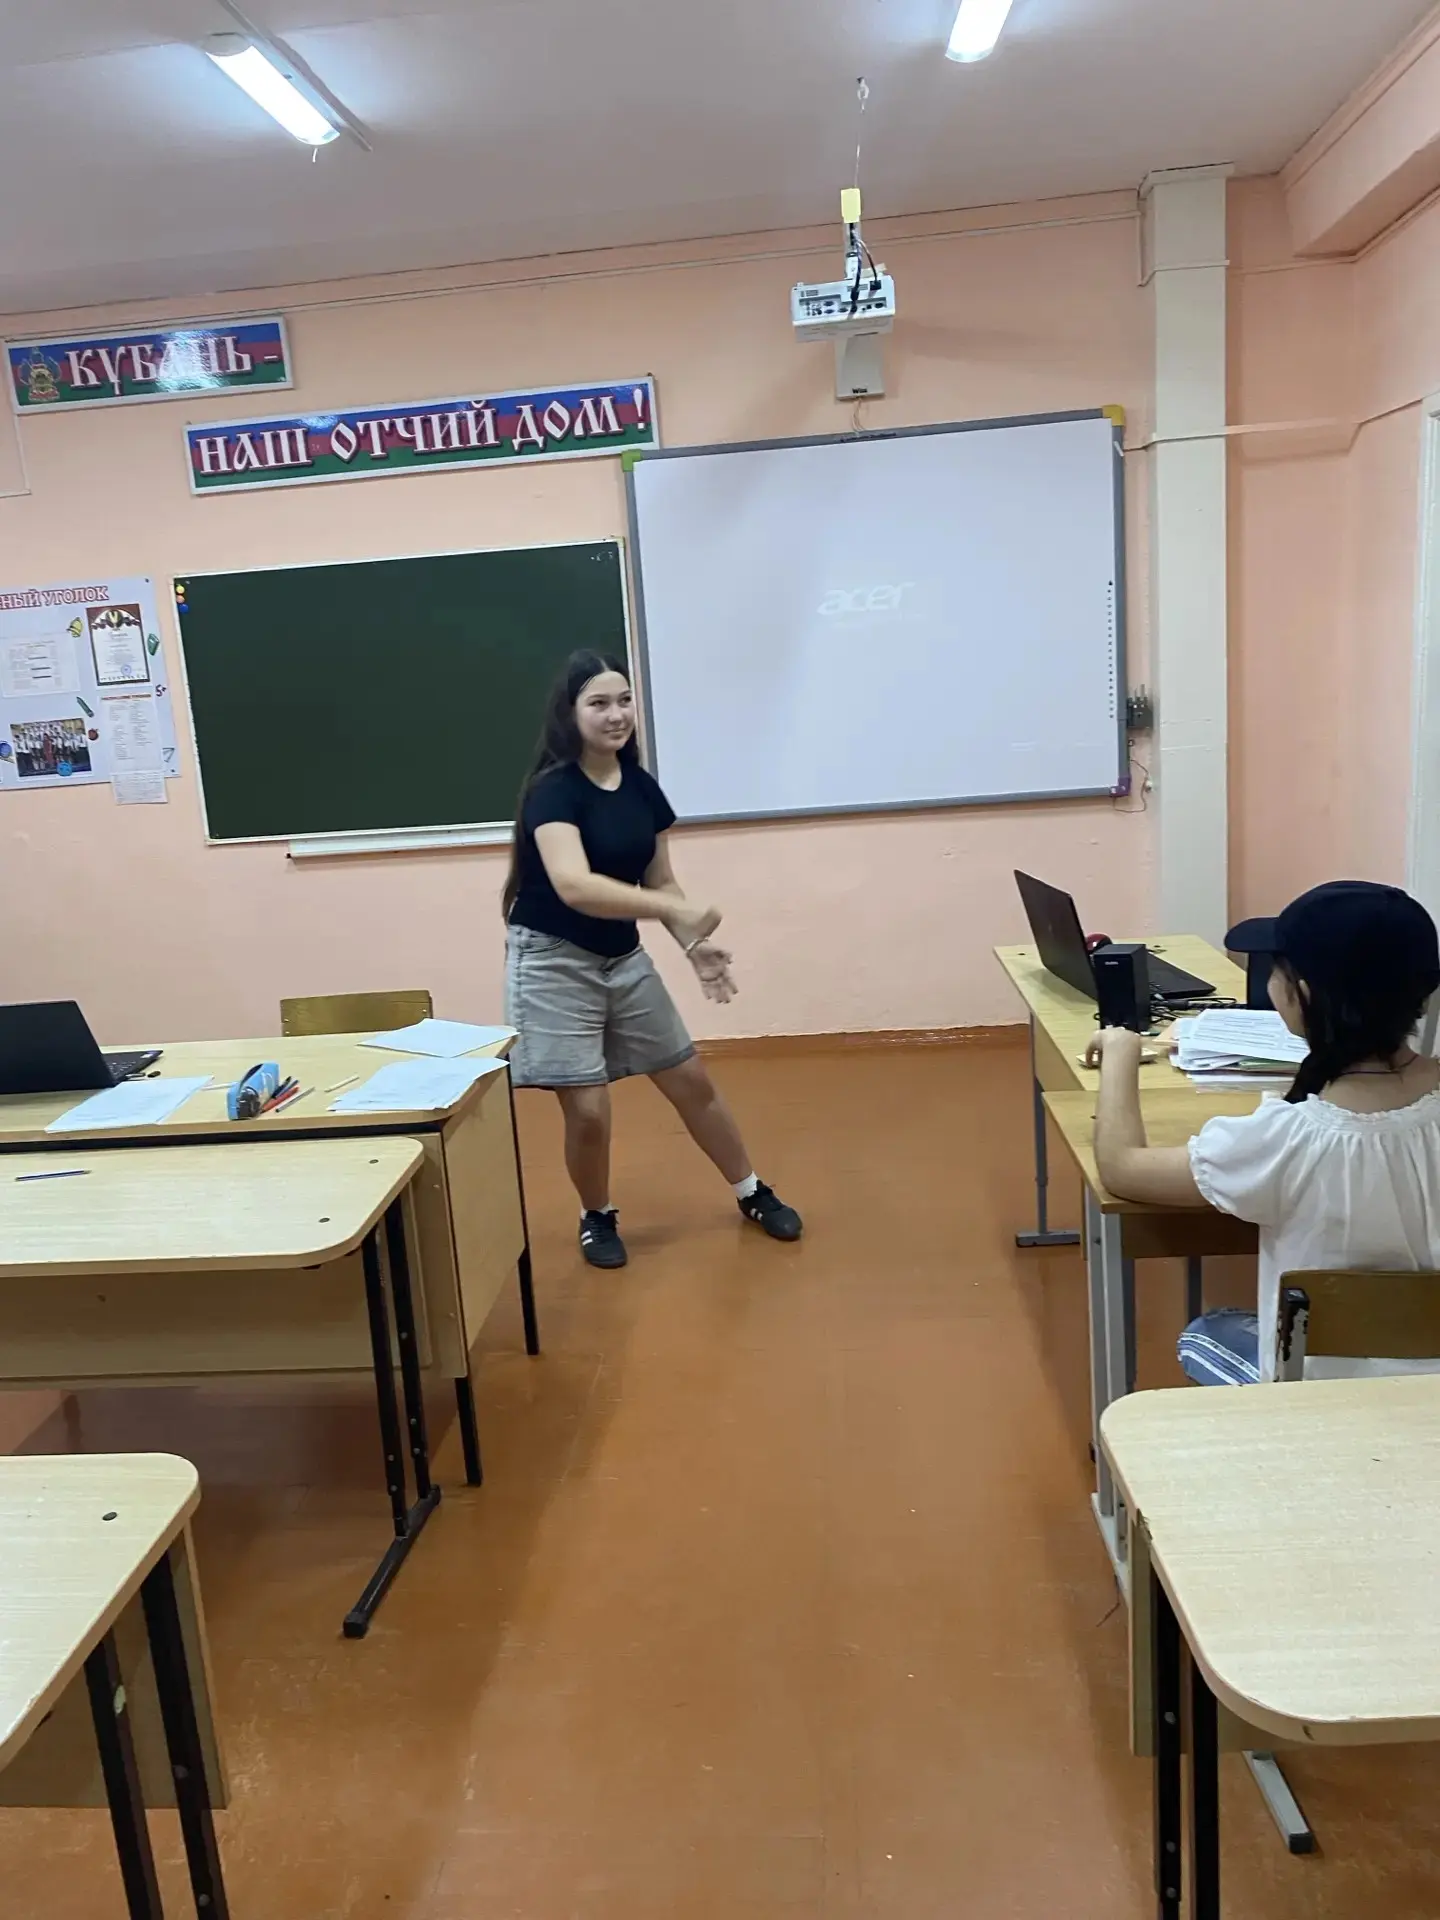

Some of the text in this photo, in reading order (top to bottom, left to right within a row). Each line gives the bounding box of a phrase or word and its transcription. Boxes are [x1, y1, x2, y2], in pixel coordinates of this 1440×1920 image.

[65, 335, 251, 395] КУБАНЬ
[196, 428, 313, 473] НАШ
[330, 399, 500, 460] ОТЧИЙ
[0, 585, 109, 609] НЫЙ УГОЛОК
[817, 582, 916, 615] acer
